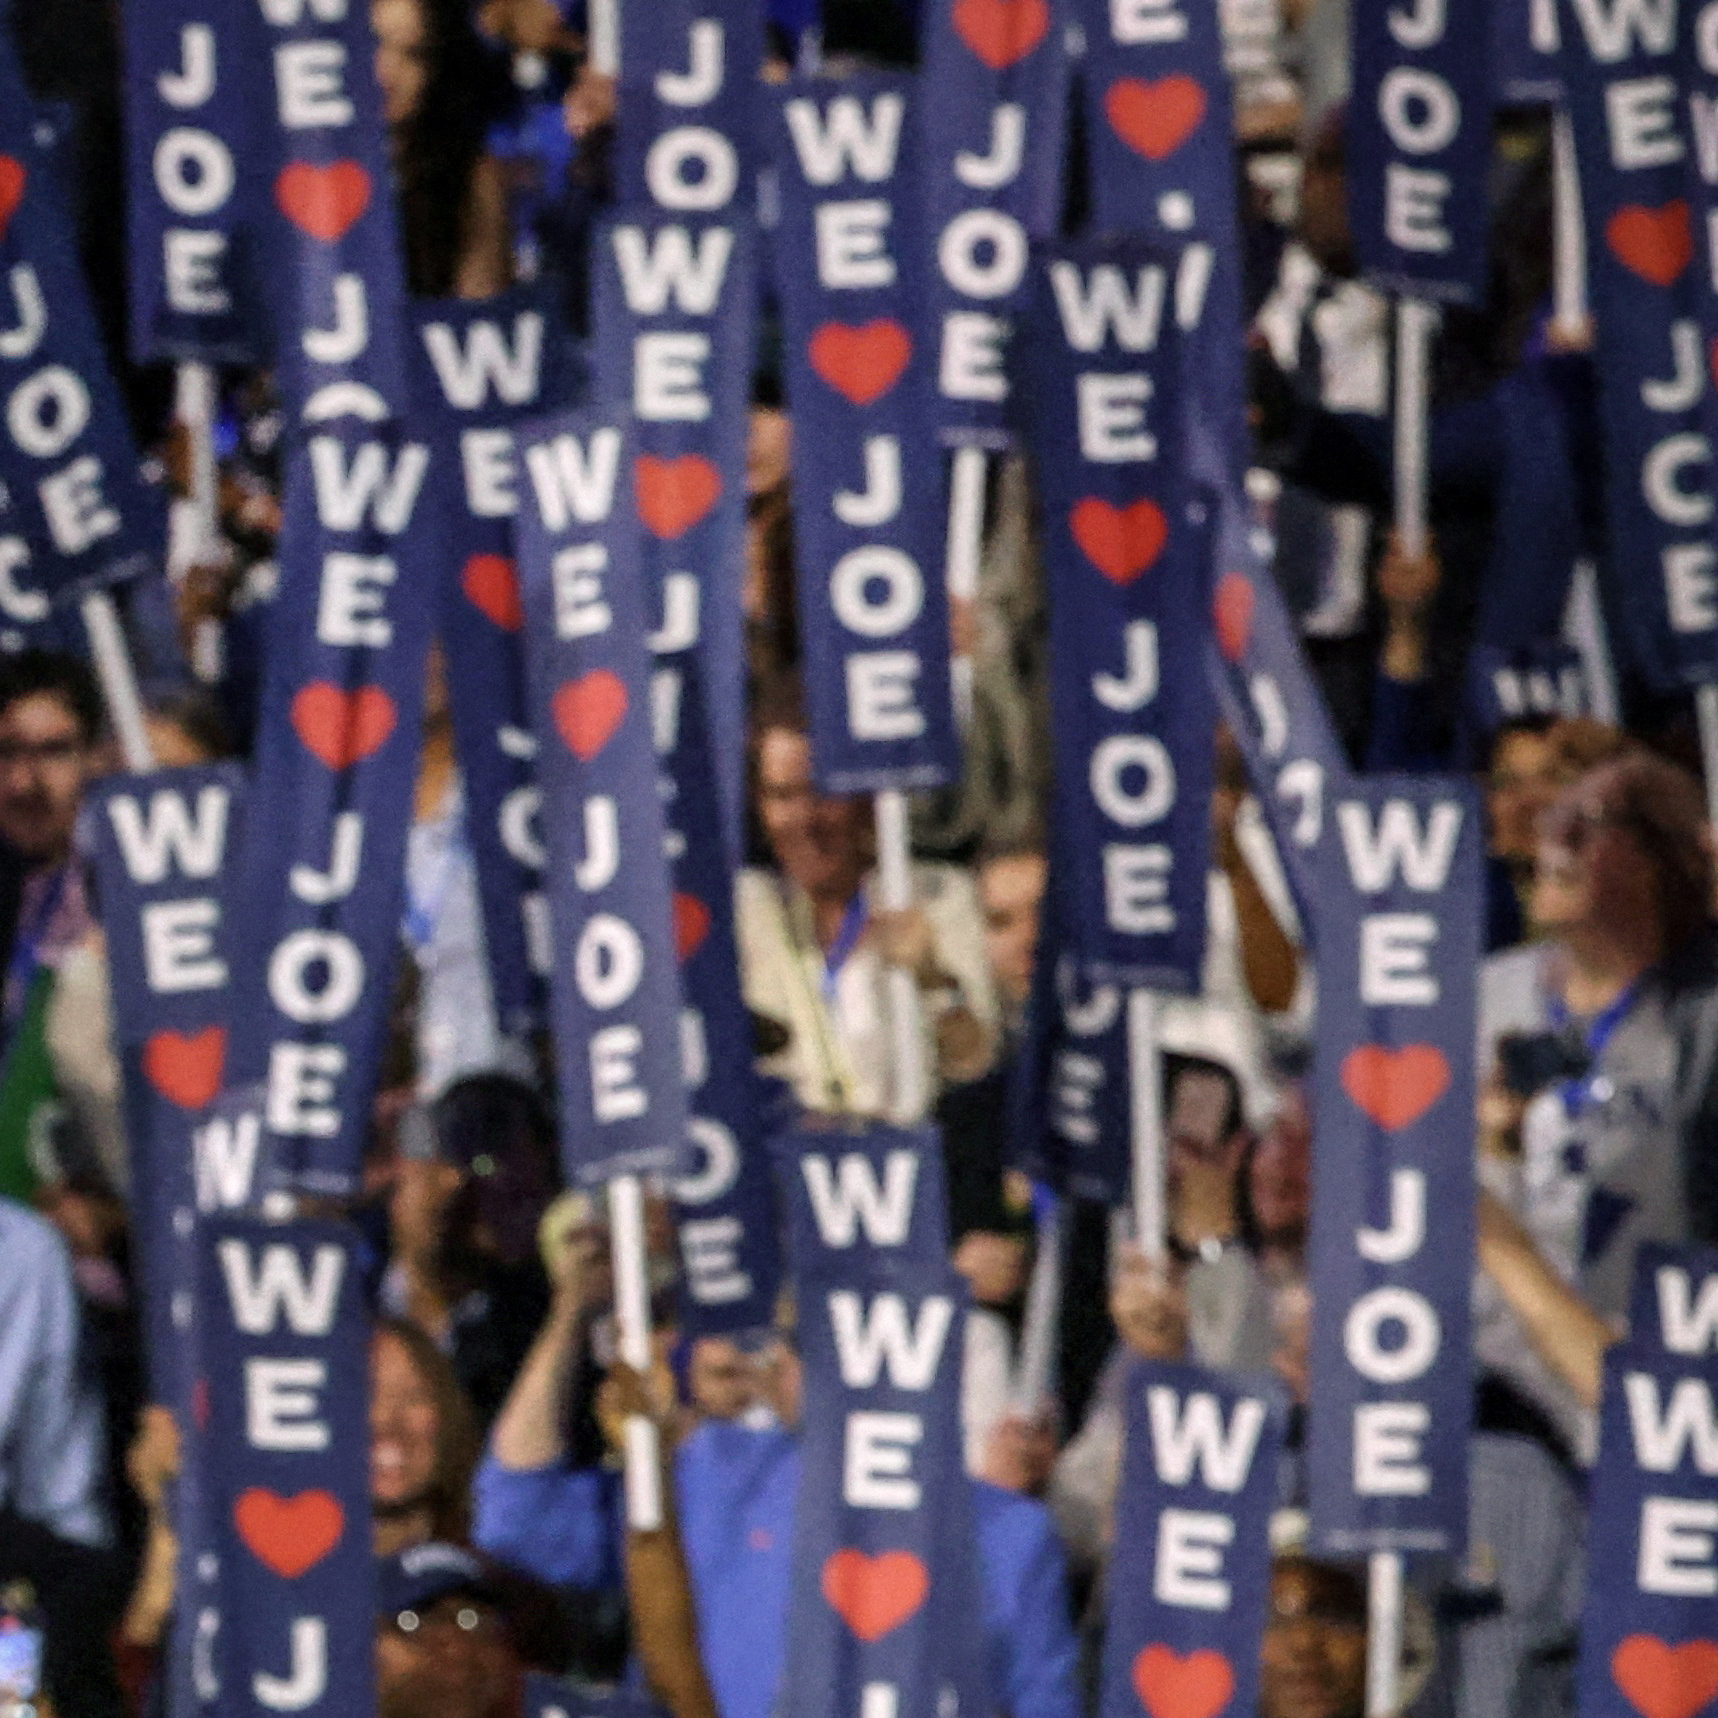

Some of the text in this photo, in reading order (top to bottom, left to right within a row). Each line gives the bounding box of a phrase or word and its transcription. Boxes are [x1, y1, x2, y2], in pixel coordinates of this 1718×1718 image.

[156, 27, 231, 309] JOE
[1383, 0, 1454, 247] JOE
[1577, 0, 1676, 165] WE
[613, 227, 732, 421] WE
[939, 106, 1025, 398] JOE
[1054, 265, 1161, 460] WE
[426, 316, 539, 515] WE
[787, 96, 922, 739] WE JOE
[310, 437, 427, 646] WE
[525, 426, 649, 1122] WE JOE
[1093, 623, 1172, 931] JOE
[109, 787, 227, 992] WE
[269, 814, 363, 1138] JOE
[1337, 800, 1460, 1495] WE JOE
[221, 1241, 342, 1449] WE
[829, 1291, 953, 1511] WE
[1148, 1387, 1267, 1610] WE
[1626, 1374, 1718, 1594] WE
